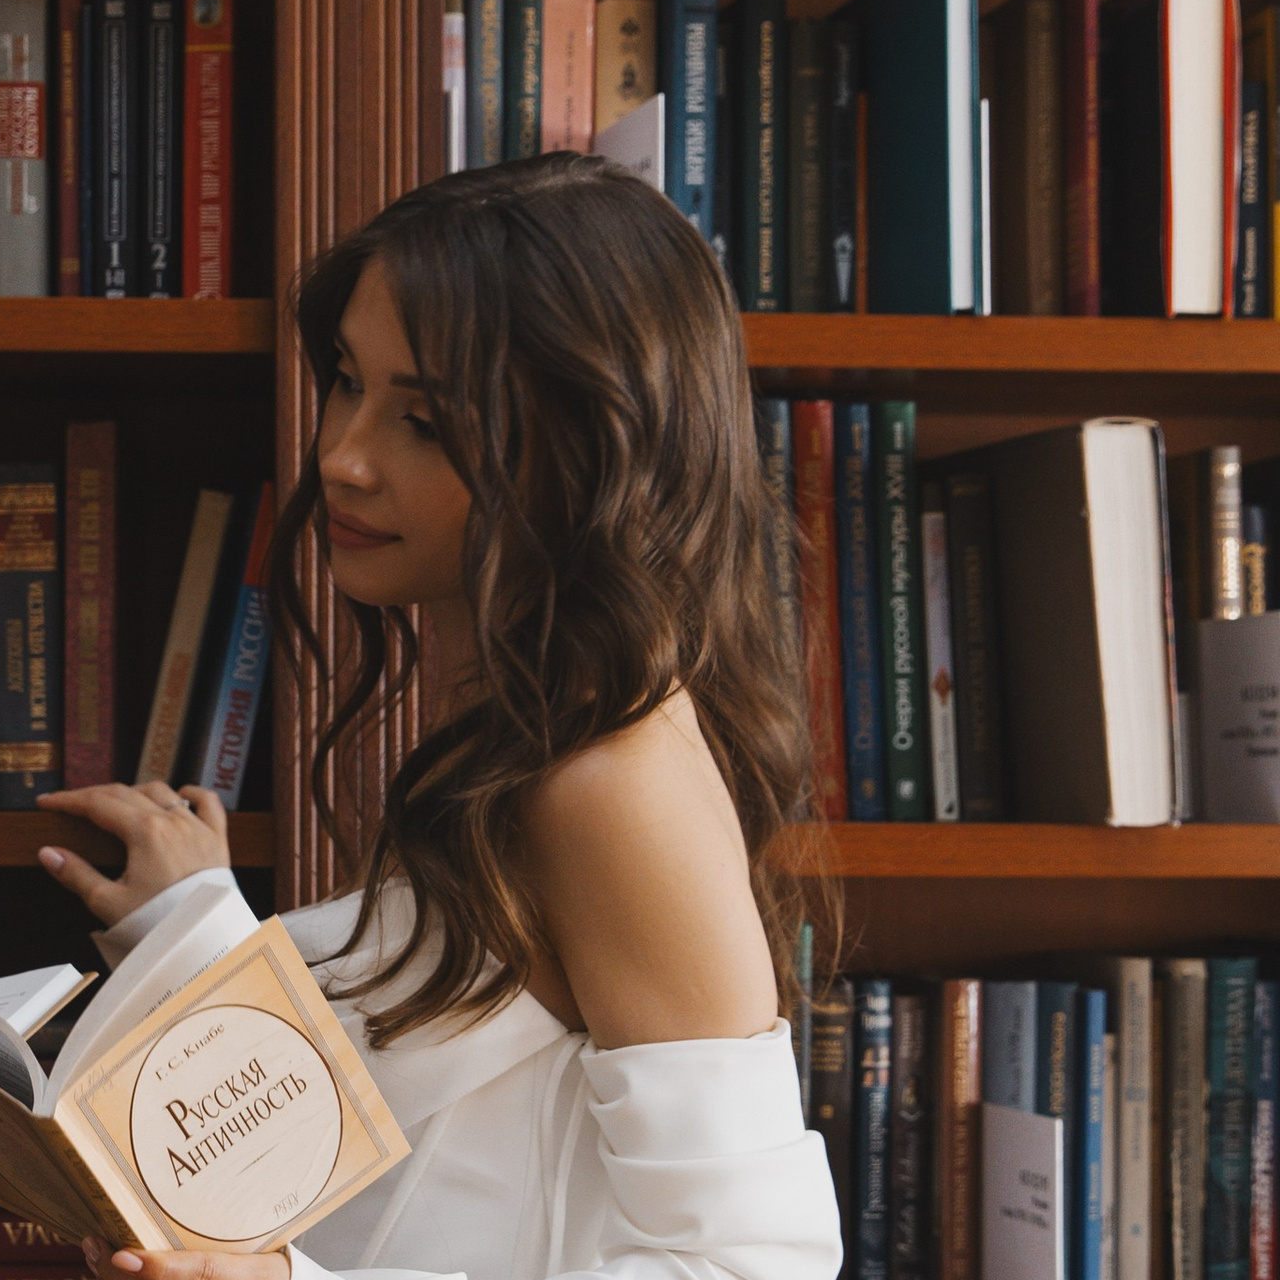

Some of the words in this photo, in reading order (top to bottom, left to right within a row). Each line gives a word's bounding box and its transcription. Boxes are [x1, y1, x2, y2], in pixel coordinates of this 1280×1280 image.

[150, 242, 168, 271] 2
[889, 505, 912, 593] культуры
[888, 596, 914, 675] русской
[211, 686, 252, 792] ИСТОРИЯ
[232, 589, 269, 683] РОССИИ
[891, 677, 915, 751] Очерки
[154, 1069, 169, 1082] Г.
[167, 1053, 185, 1073] С.
[181, 1022, 226, 1059] Кнабе
